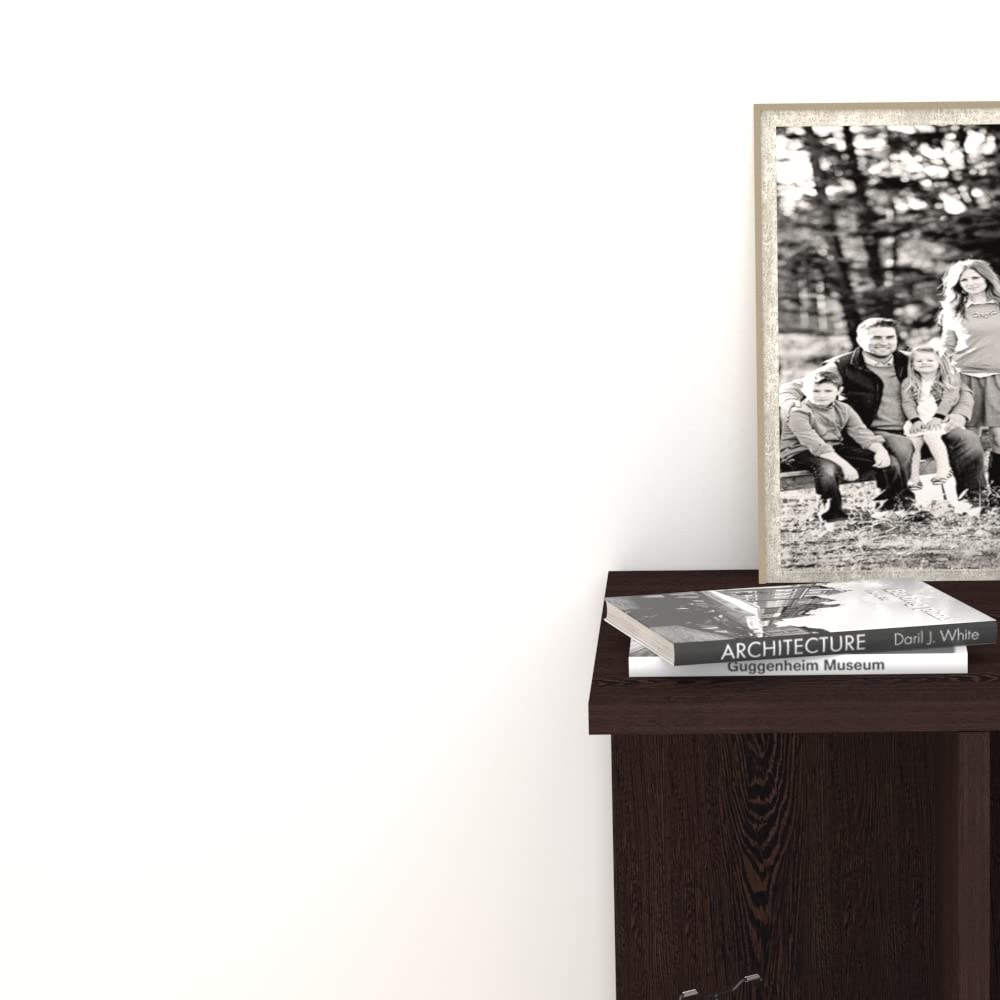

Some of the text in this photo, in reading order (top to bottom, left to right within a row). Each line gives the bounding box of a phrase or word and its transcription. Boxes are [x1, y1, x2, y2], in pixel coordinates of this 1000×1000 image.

[720, 627, 980, 661] ARCHITECTURE Daril J. White
[727, 657, 885, 674] Guggenheim Museum
